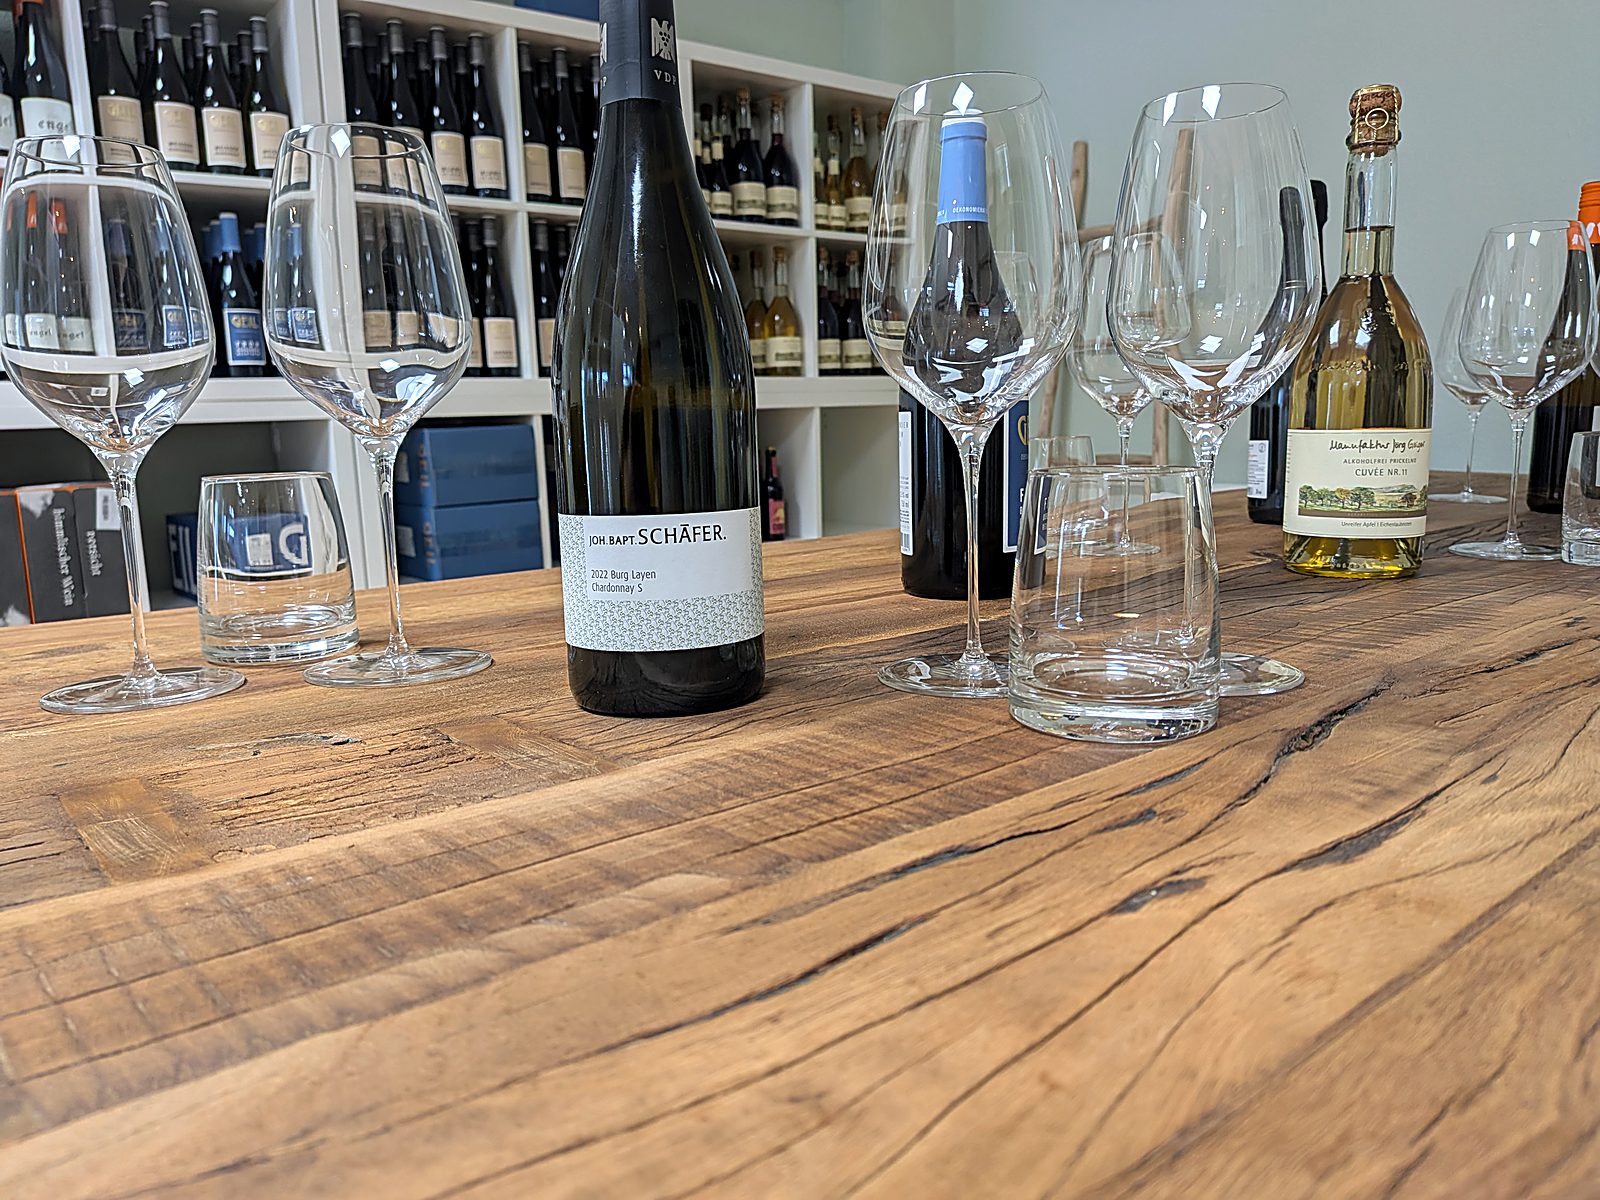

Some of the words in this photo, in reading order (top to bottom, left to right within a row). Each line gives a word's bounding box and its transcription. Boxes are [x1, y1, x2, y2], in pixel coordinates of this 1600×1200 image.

[1355, 466, 1384, 477] CUVÉE
[591, 569, 608, 579] 2022
[610, 569, 629, 580] Burg
[631, 570, 656, 580] Layen
[591, 583, 635, 595] Chardonnay
[637, 583, 643, 593] S
